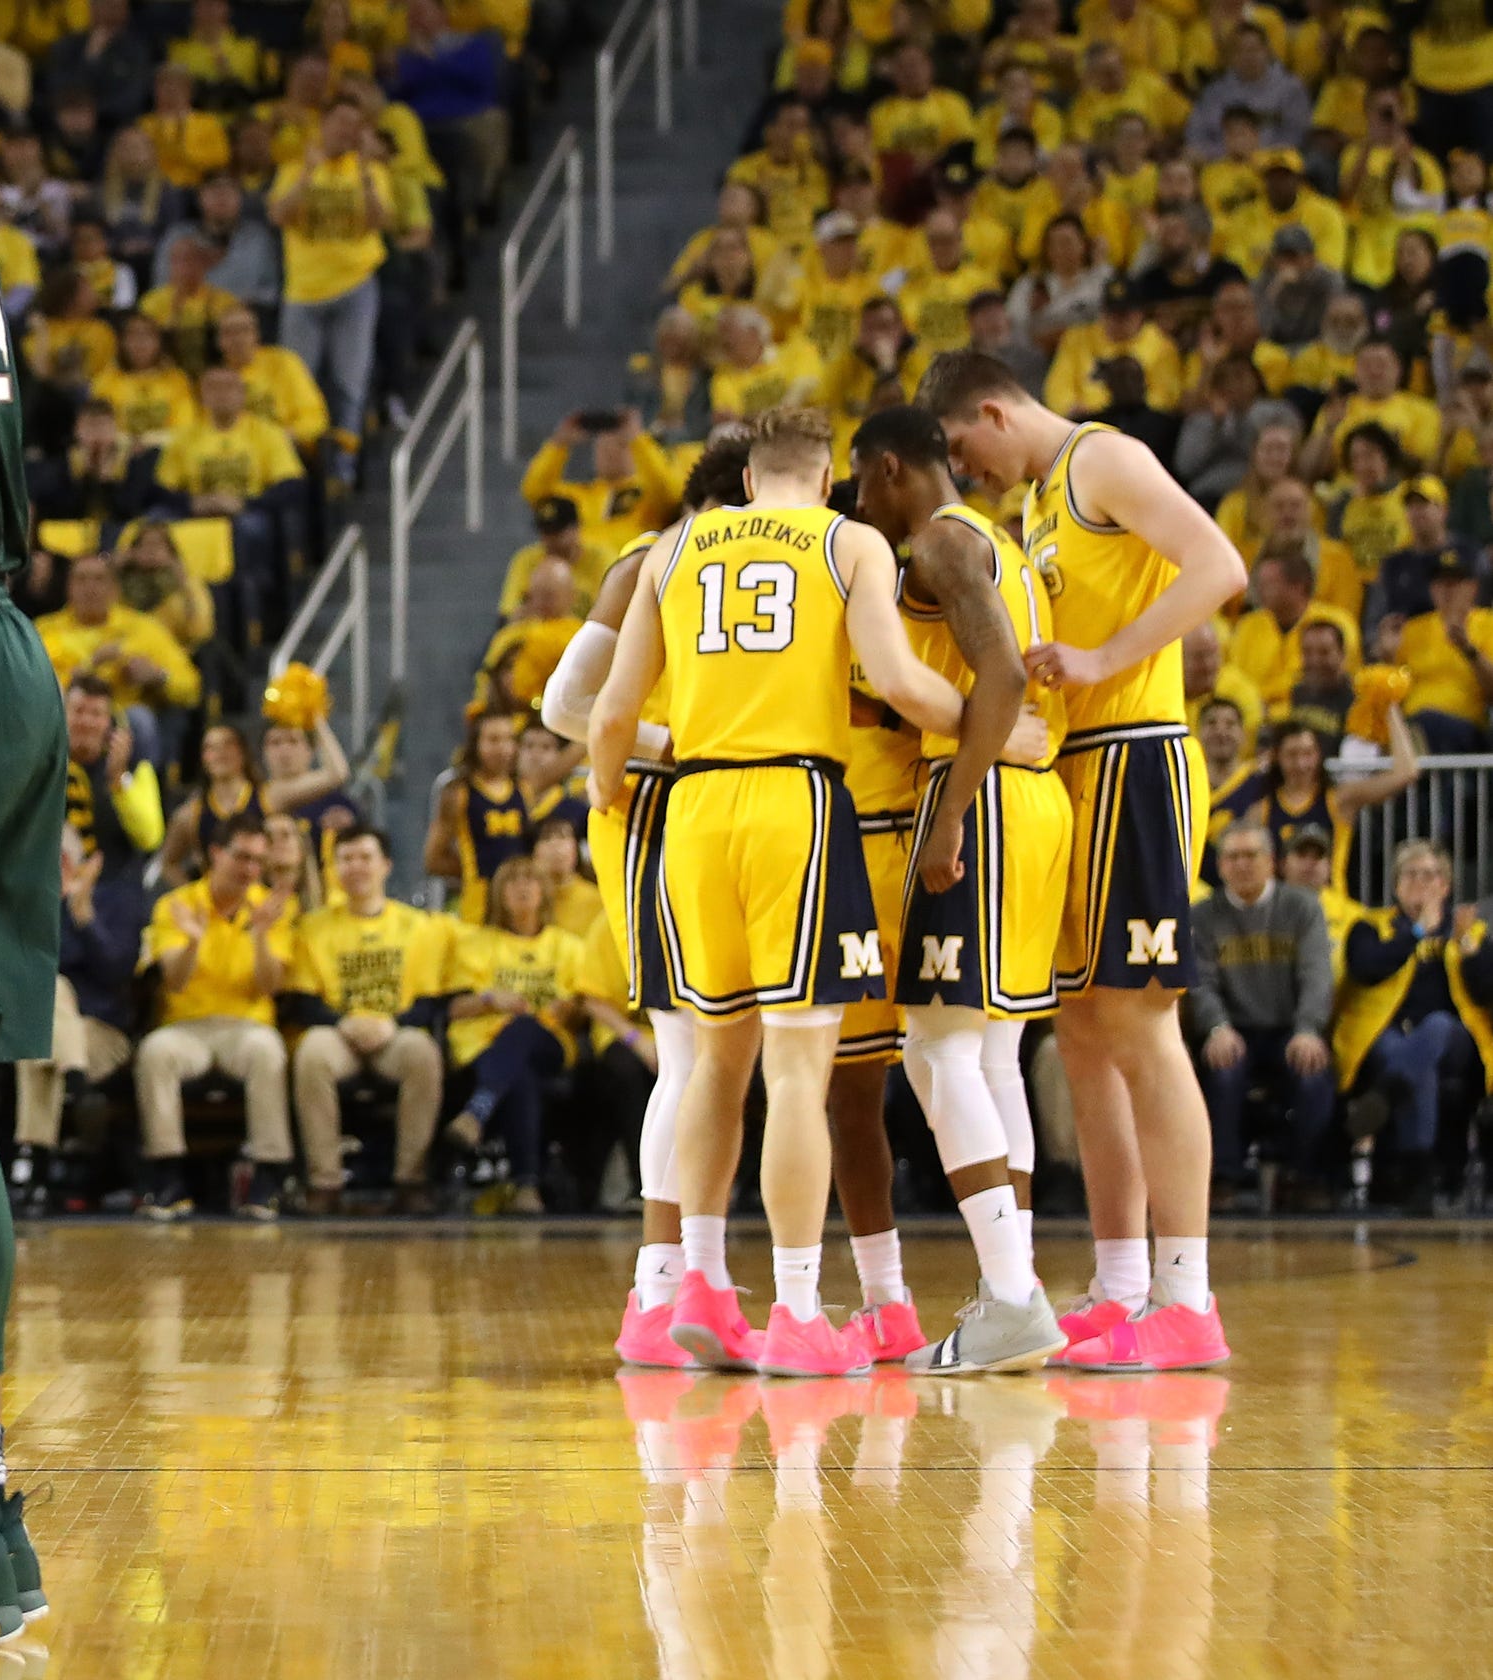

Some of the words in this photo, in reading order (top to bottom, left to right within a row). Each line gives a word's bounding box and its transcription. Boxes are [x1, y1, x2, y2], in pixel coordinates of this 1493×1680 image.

[694, 516, 818, 552] BRAZDEIKIS
[696, 561, 798, 655] 13
[838, 929, 884, 980] M
[918, 934, 965, 982] M
[1126, 918, 1179, 966] M
